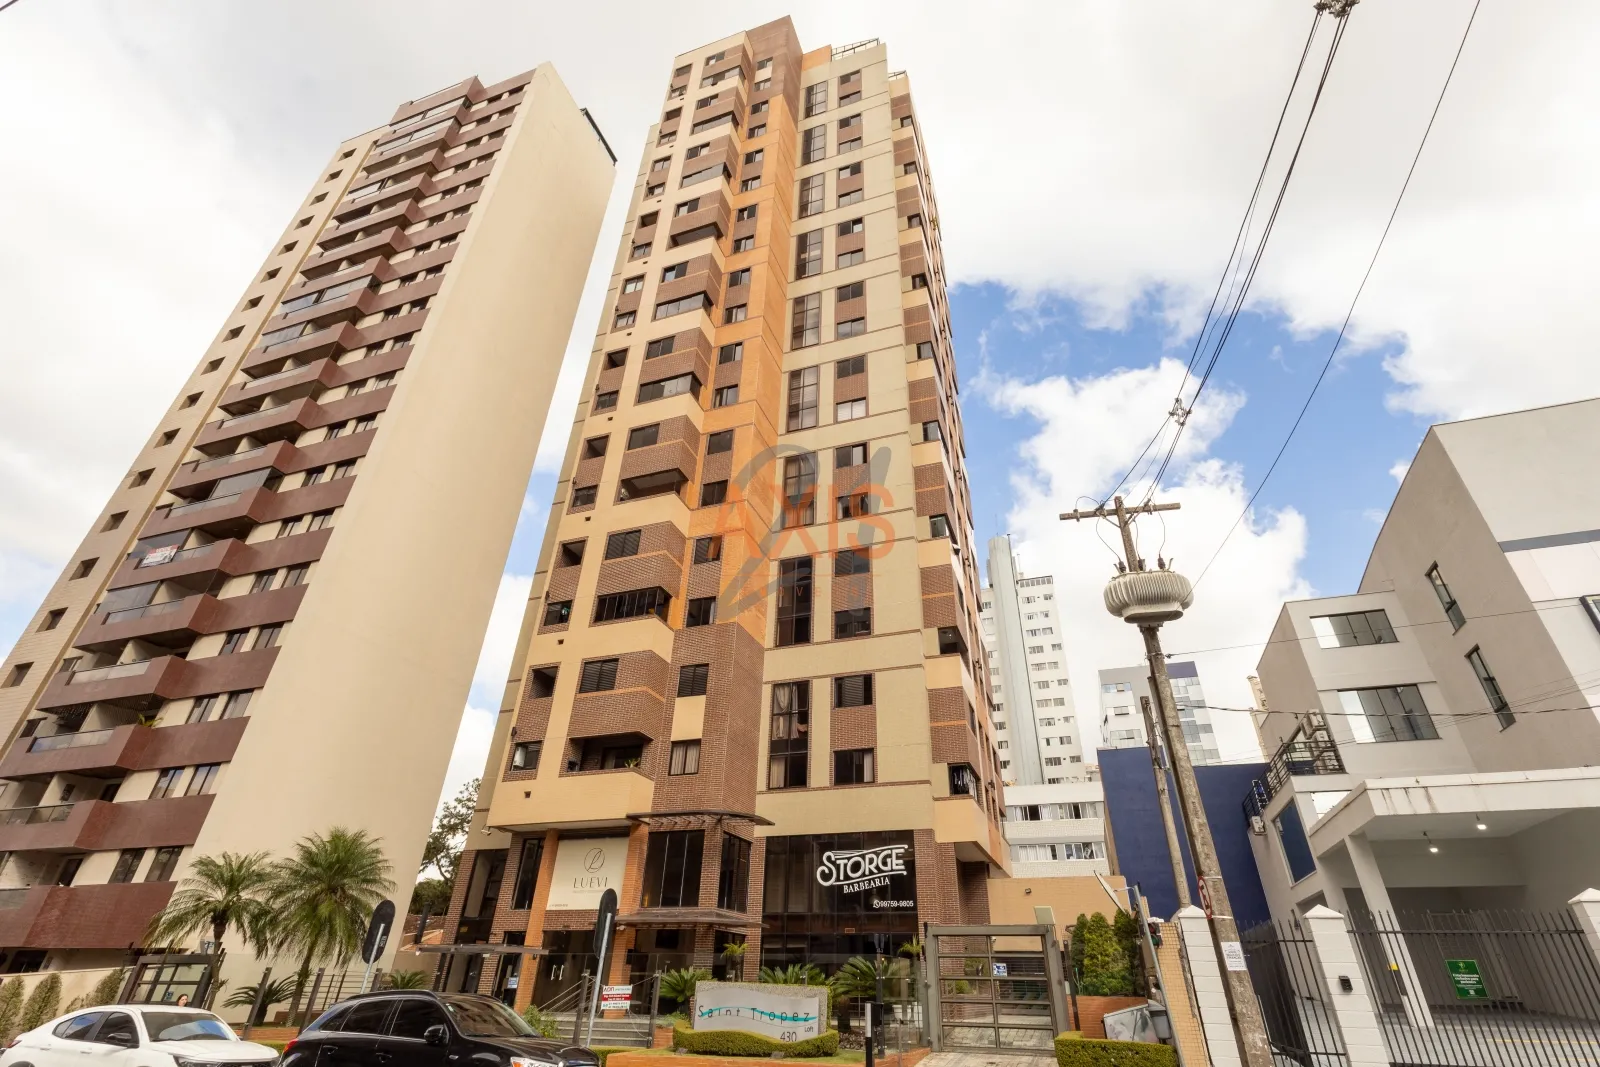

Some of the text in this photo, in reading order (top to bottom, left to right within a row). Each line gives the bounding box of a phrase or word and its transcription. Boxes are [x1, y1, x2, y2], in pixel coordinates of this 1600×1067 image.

[816, 848, 906, 887] STORGE
[573, 877, 608, 889] LUEVI
[843, 877, 890, 893] BARBEARIA
[697, 1005, 810, 1024] Saint Tropez
[780, 1031, 797, 1042] 430
